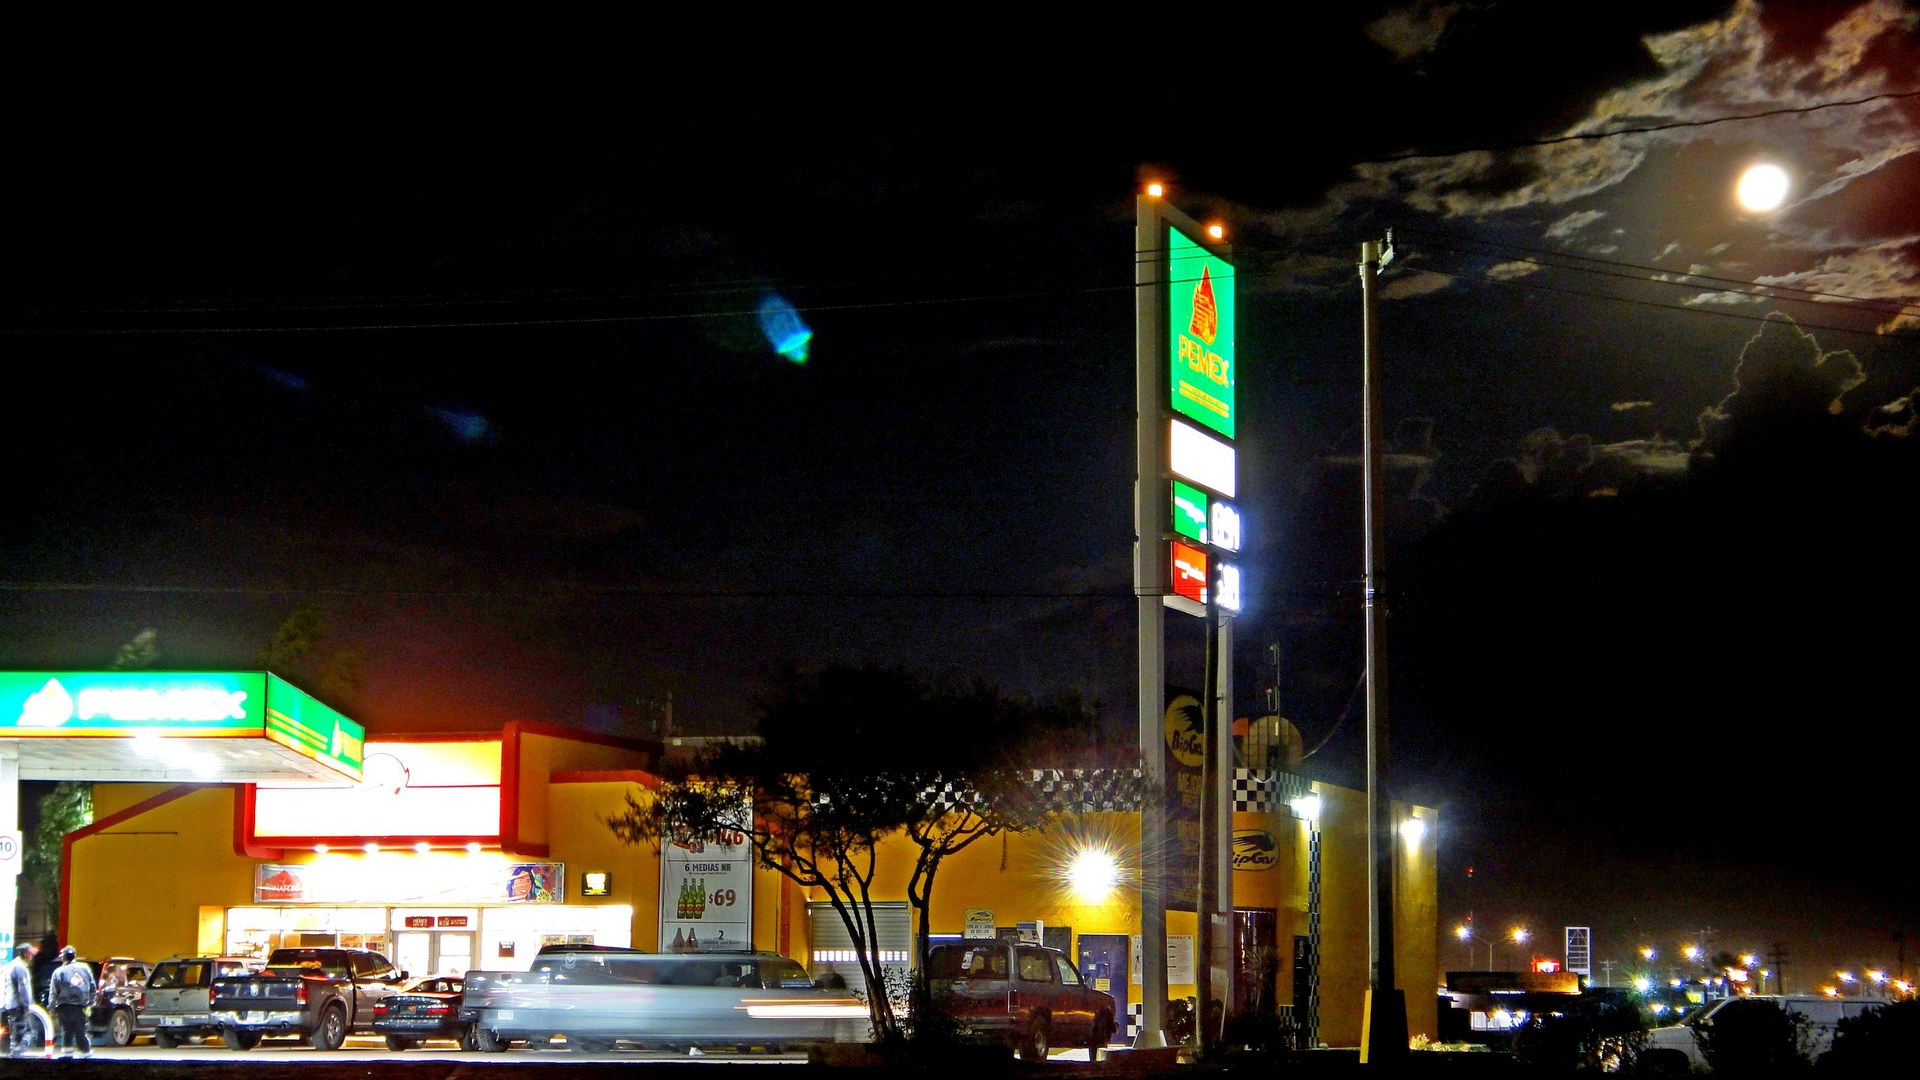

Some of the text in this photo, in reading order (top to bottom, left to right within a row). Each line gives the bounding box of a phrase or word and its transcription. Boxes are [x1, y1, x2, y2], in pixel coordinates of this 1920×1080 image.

[1178, 334, 1229, 388] PEMEX
[78, 688, 247, 721] PMX
[684, 863, 732, 872] 6 MEDIAS NR
[708, 889, 737, 907] $69
[718, 930, 724, 941] 2
